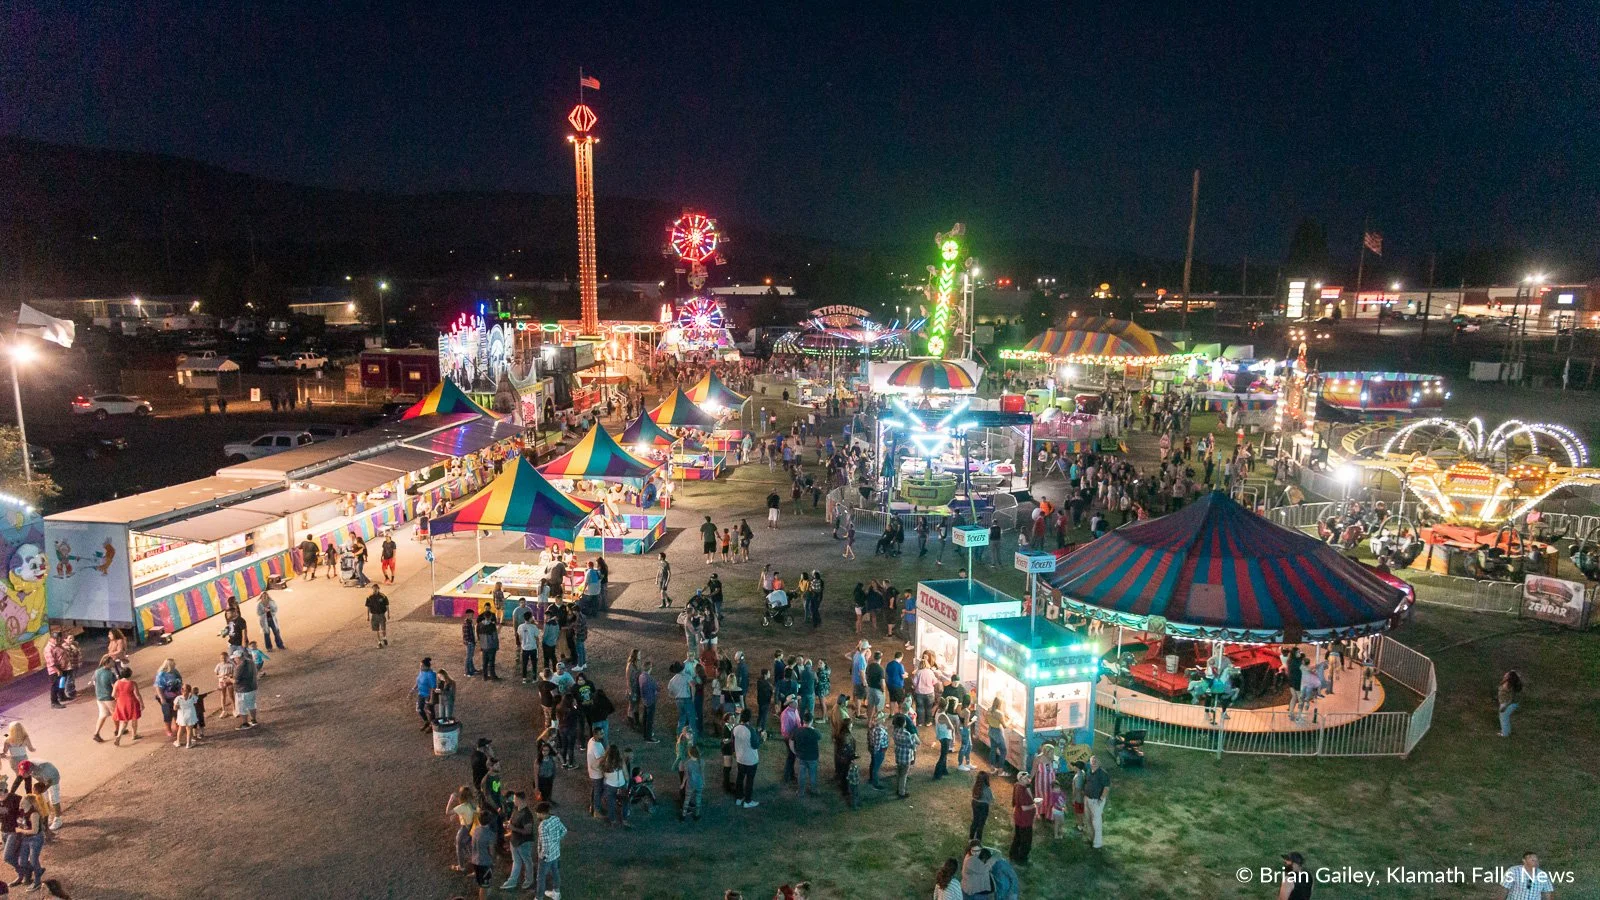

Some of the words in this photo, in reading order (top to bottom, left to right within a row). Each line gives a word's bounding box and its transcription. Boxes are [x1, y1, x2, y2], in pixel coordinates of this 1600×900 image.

[809, 304, 872, 318] STARSHIP
[966, 534, 986, 543] TICKETS
[1030, 560, 1053, 570] TICKETS
[920, 591, 958, 621] TICKETS
[1528, 602, 1567, 617] ZENDAR
